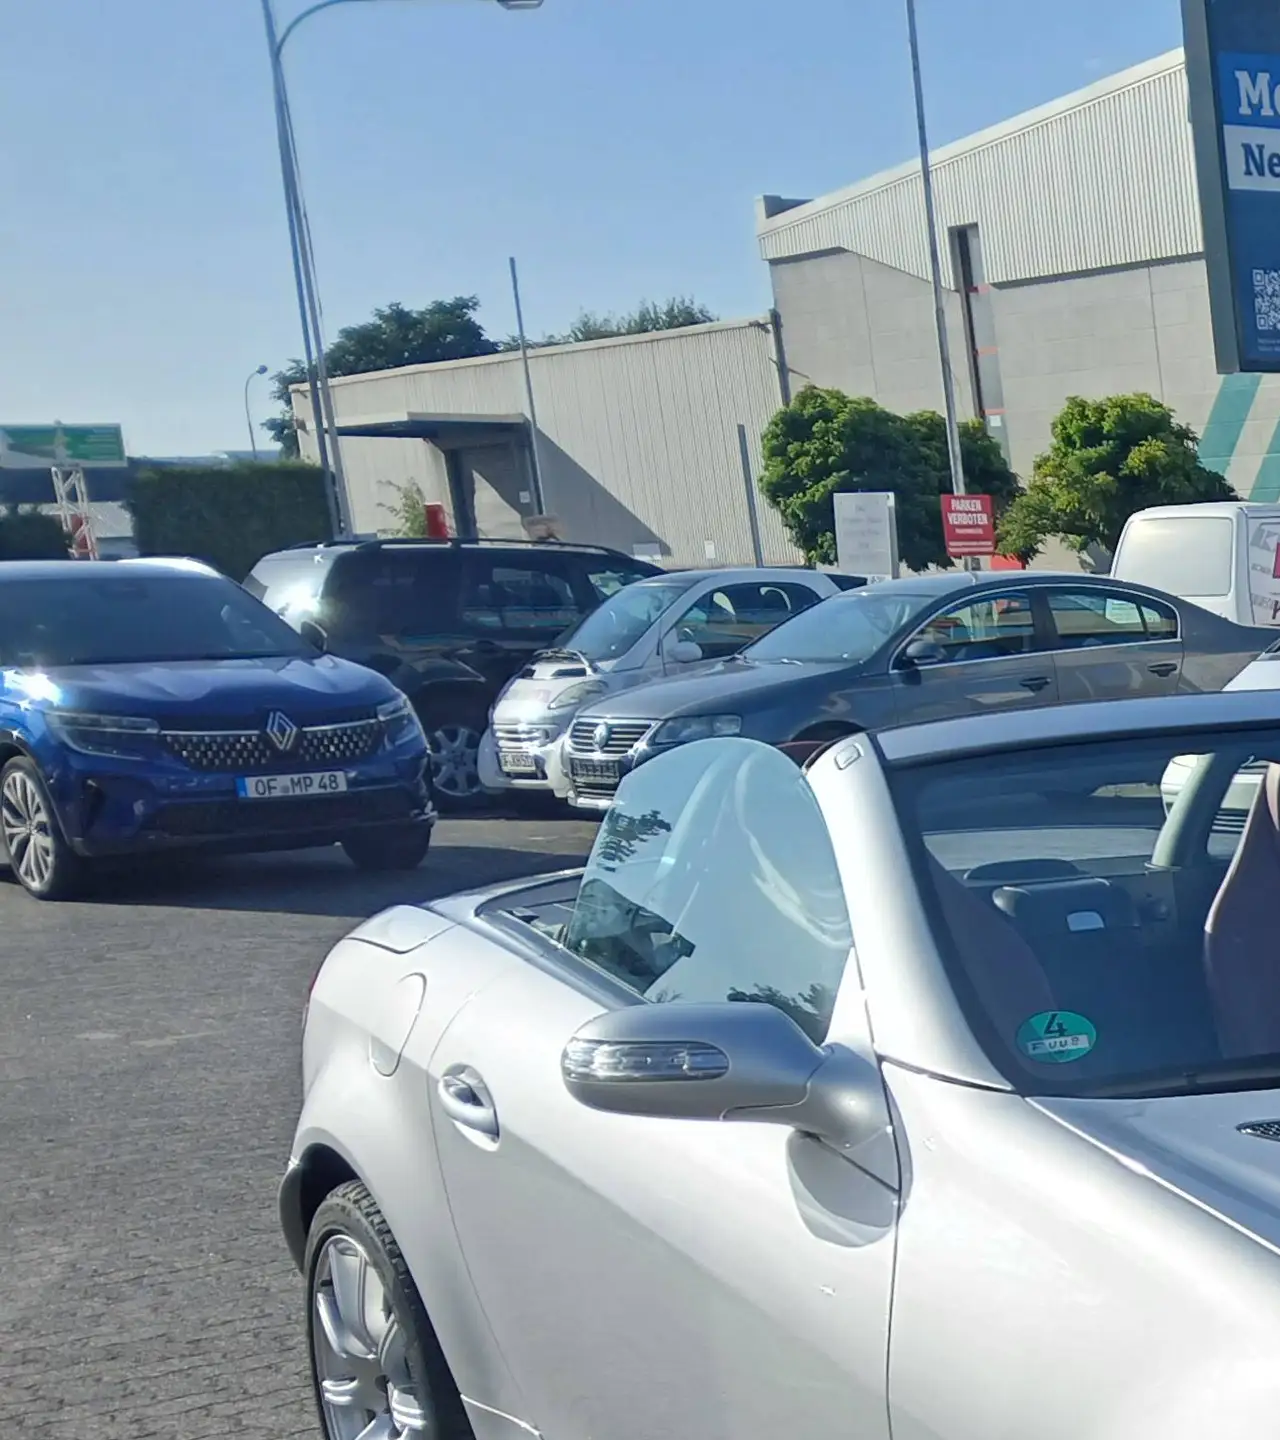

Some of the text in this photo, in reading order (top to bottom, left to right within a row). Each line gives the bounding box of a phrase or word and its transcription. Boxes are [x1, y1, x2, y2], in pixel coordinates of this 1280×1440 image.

[951, 499, 982, 511] PARKEN
[947, 512, 988, 525] VERBOTEN
[255, 774, 339, 796] OF MP 48
[1044, 1013, 1068, 1037] 4
